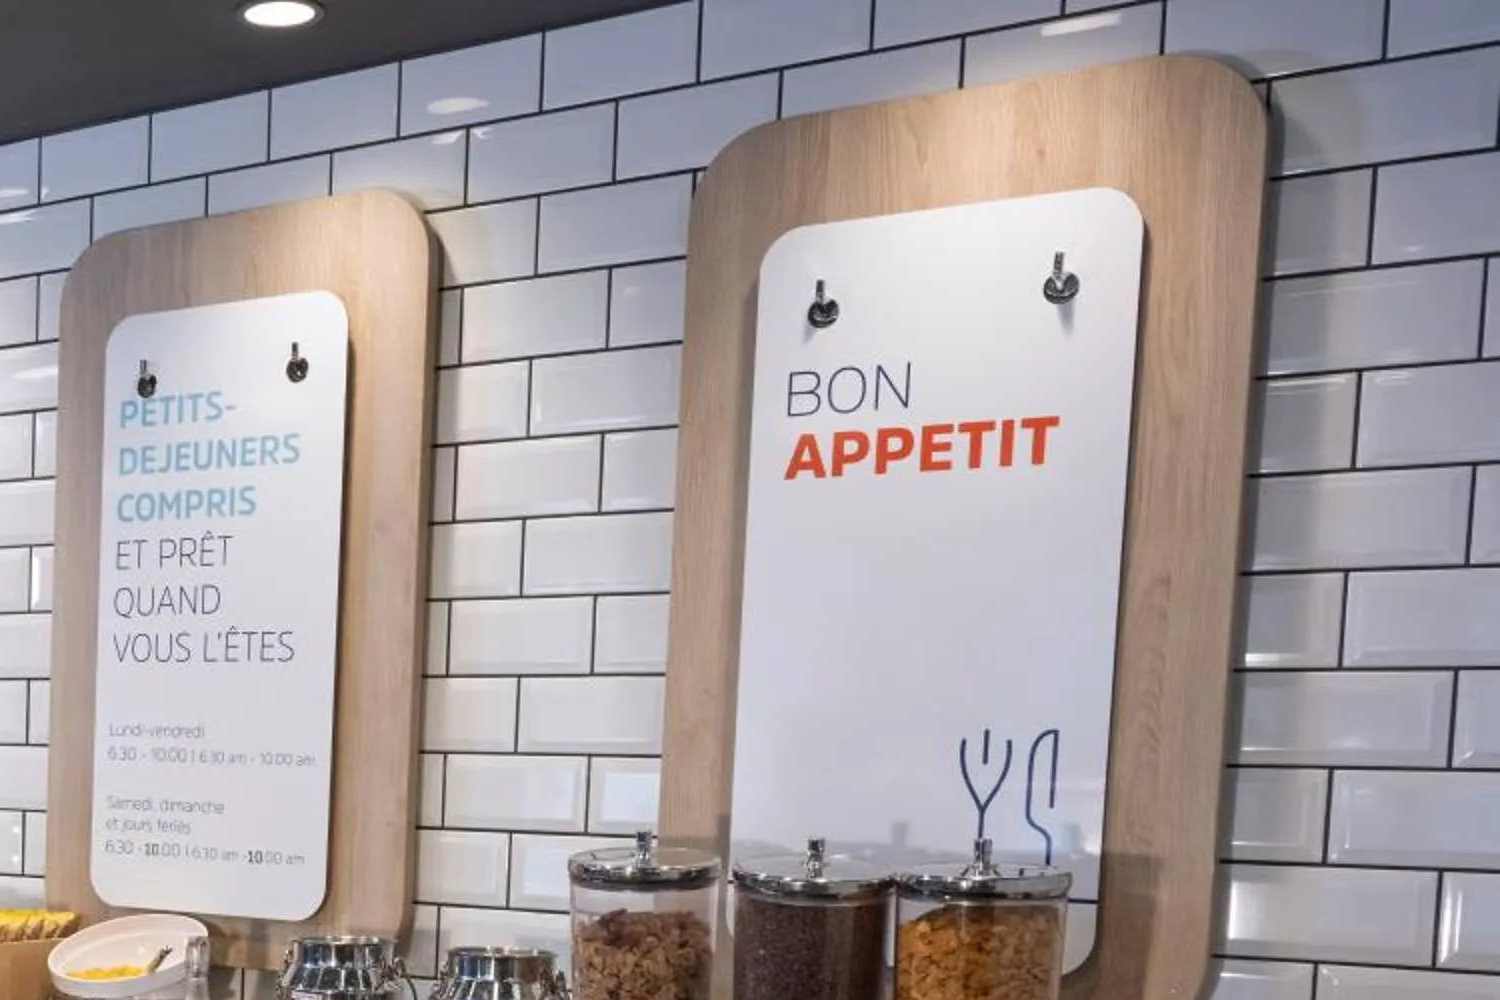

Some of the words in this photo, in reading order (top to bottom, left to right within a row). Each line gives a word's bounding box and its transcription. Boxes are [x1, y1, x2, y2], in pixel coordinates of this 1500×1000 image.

[786, 361, 912, 417] BON
[119, 391, 237, 428] PETITS-
[118, 433, 300, 476] DEJEUNERS
[784, 416, 1060, 480] APPETIT
[117, 486, 257, 522] COMPRIS
[115, 539, 148, 570] ET
[159, 530, 233, 569] PRÊT
[113, 584, 221, 618] QUAND
[113, 632, 191, 663] VOUS
[203, 625, 295, 662] L'ÊTES
